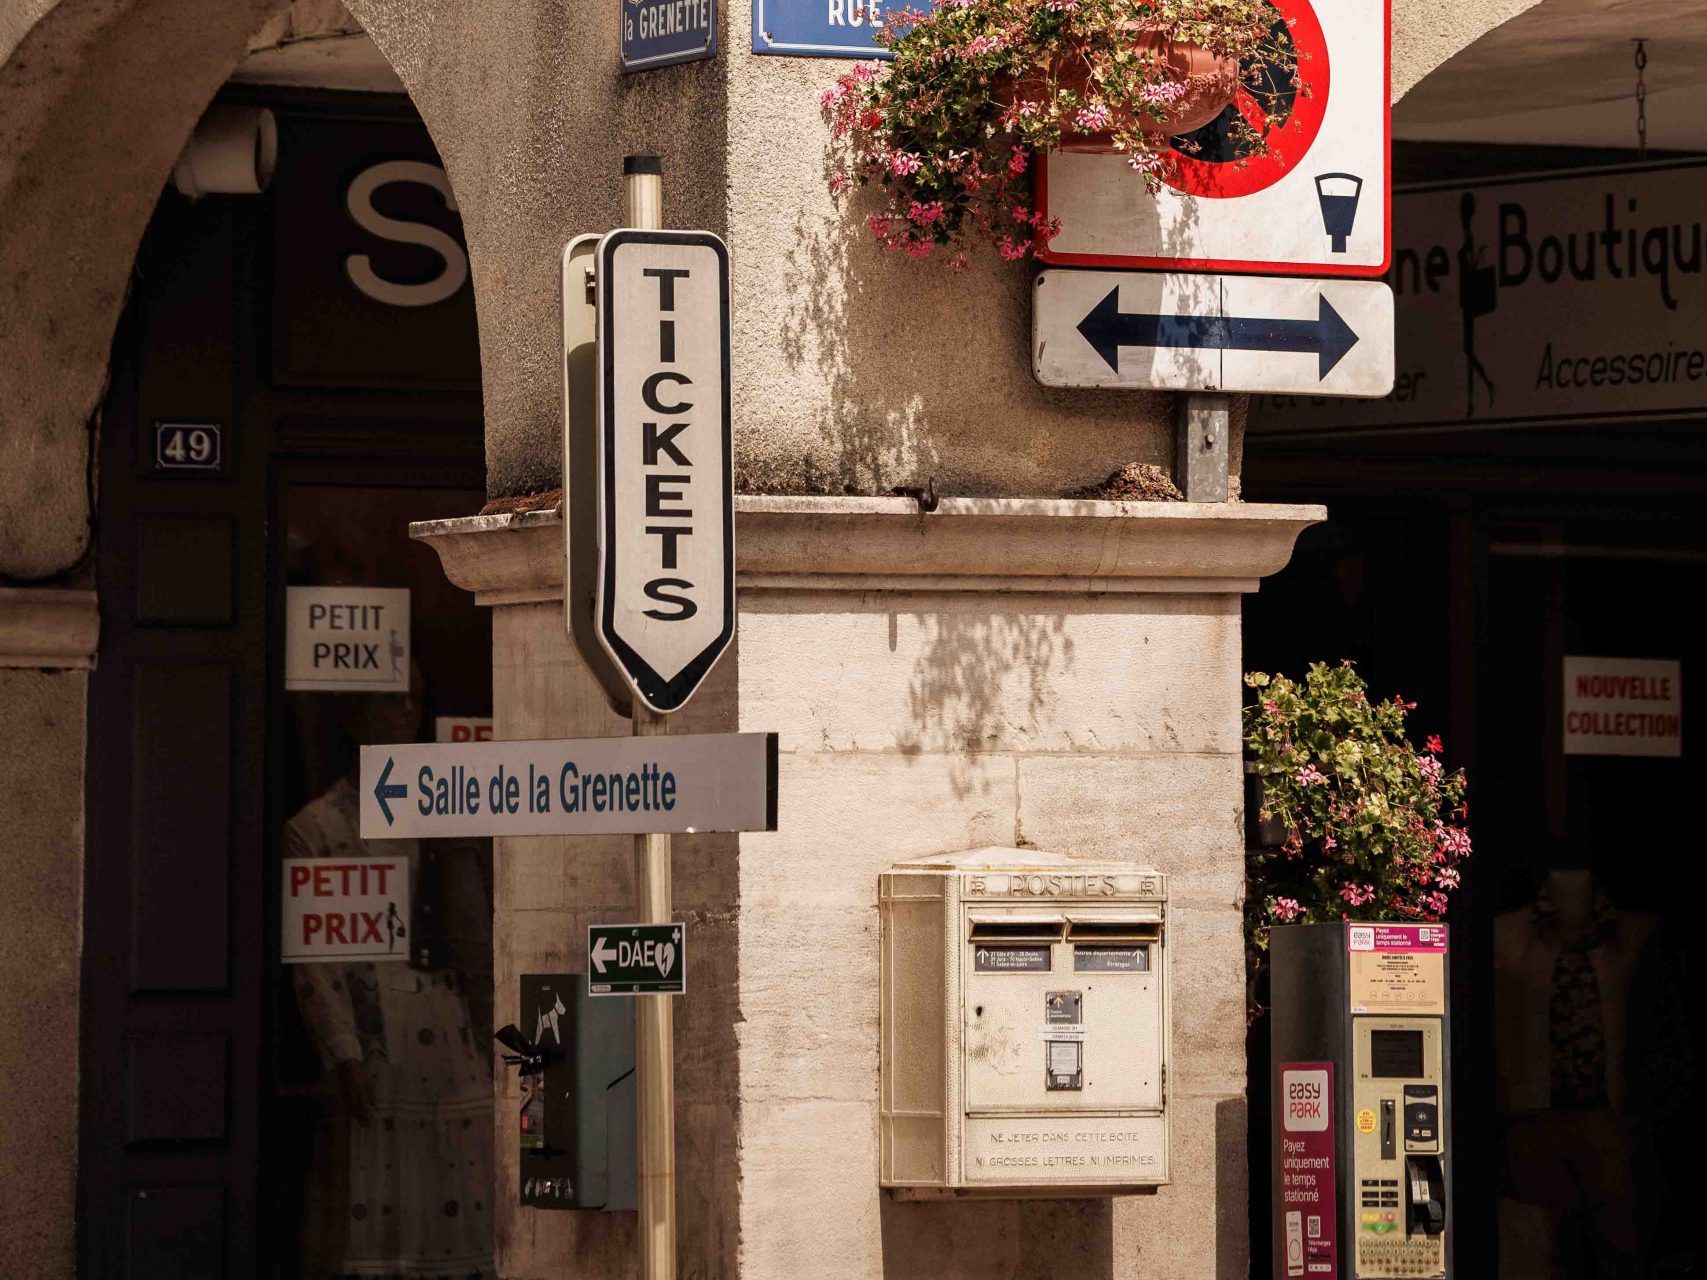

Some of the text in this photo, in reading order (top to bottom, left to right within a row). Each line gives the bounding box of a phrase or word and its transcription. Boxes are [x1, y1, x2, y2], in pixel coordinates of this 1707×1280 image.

[624, 10, 633, 42] la
[1499, 193, 1707, 311] Boutiqu
[1535, 341, 1707, 391] Accessoire
[164, 429, 212, 462] 49
[642, 268, 698, 621] TICKETS
[309, 604, 385, 630] PETIT
[313, 643, 379, 669] PRIX
[1576, 674, 1672, 701] NOUVELLE
[1566, 711, 1679, 738] COLLECTION
[417, 761, 677, 816] Salle de la Grenette
[290, 863, 396, 897] PETIT
[1011, 875, 1117, 896] POSTES
[302, 911, 385, 945] PRIX
[618, 940, 655, 967] DAE
[1290, 1083, 1320, 1099] easy
[990, 1133, 1004, 1143] NE
[1007, 1133, 1038, 1142] JETER
[1042, 1132, 1070, 1142] DANS
[1075, 1132, 1107, 1142] CETTE
[1283, 1138, 1305, 1155] Payez
[989, 1157, 1038, 1166] GROSSES
[1043, 1156, 1086, 1166] LETTRES
[1090, 1156, 1100, 1165] NI
[1283, 1156, 1330, 1171] uniquement
[1283, 1172, 1316, 1188] le temps
[1284, 1188, 1319, 1202] stationné
